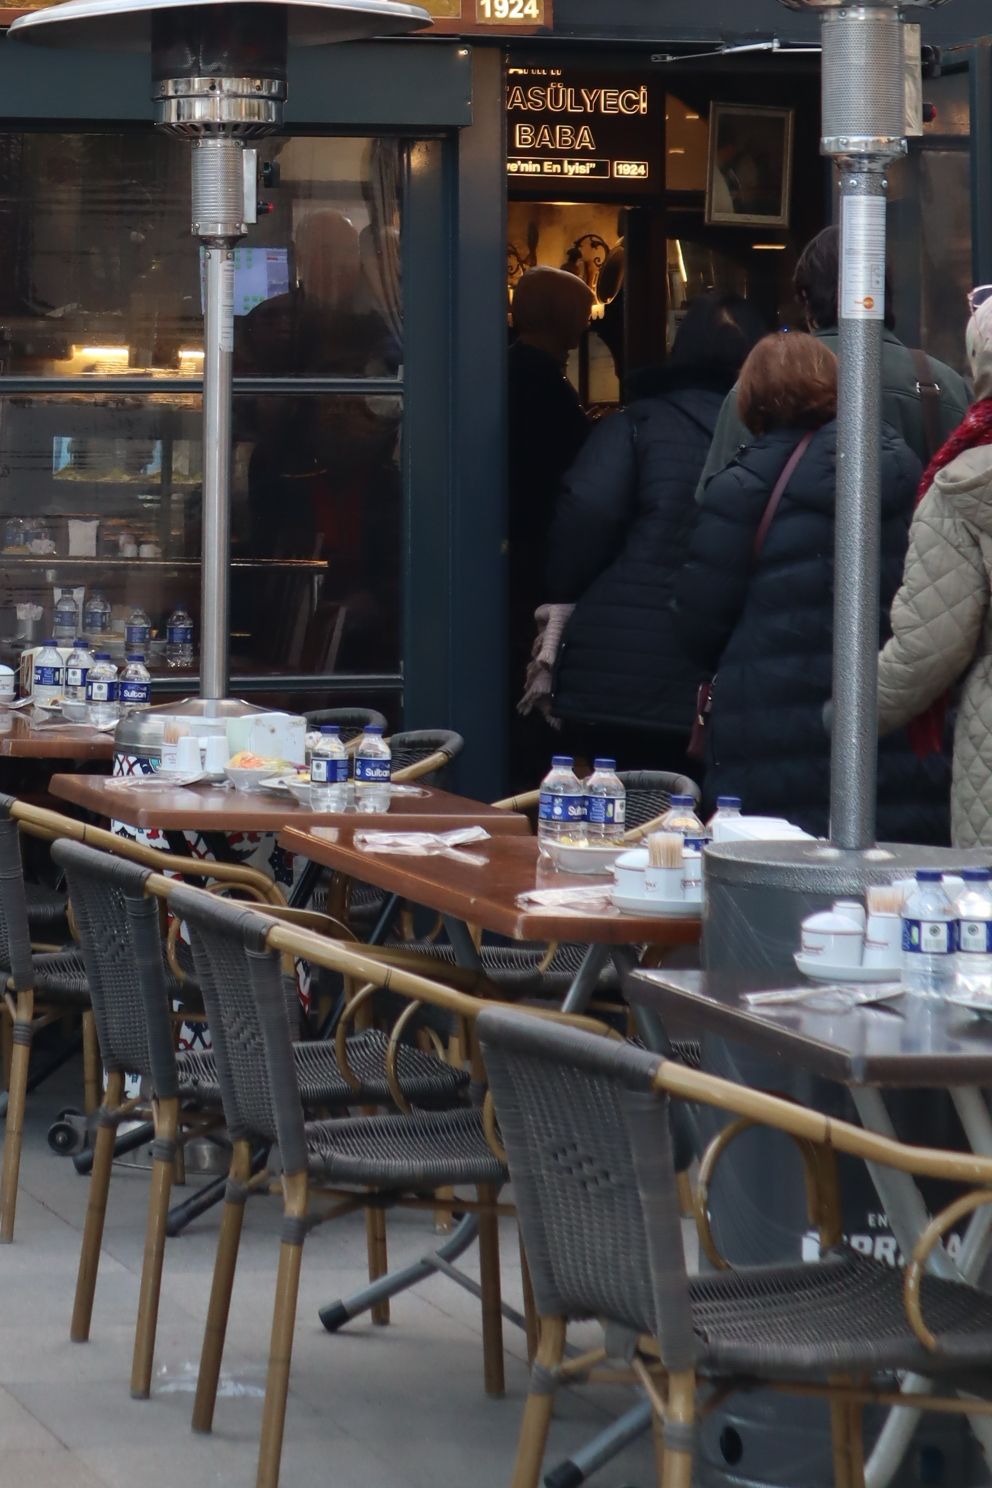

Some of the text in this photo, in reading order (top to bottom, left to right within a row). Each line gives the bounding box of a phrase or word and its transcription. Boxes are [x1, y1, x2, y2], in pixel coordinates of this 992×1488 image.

[507, 82, 648, 115] ASÜLYECİ
[515, 123, 596, 150] BABA
[543, 161, 561, 173] En
[617, 163, 646, 176] 1924
